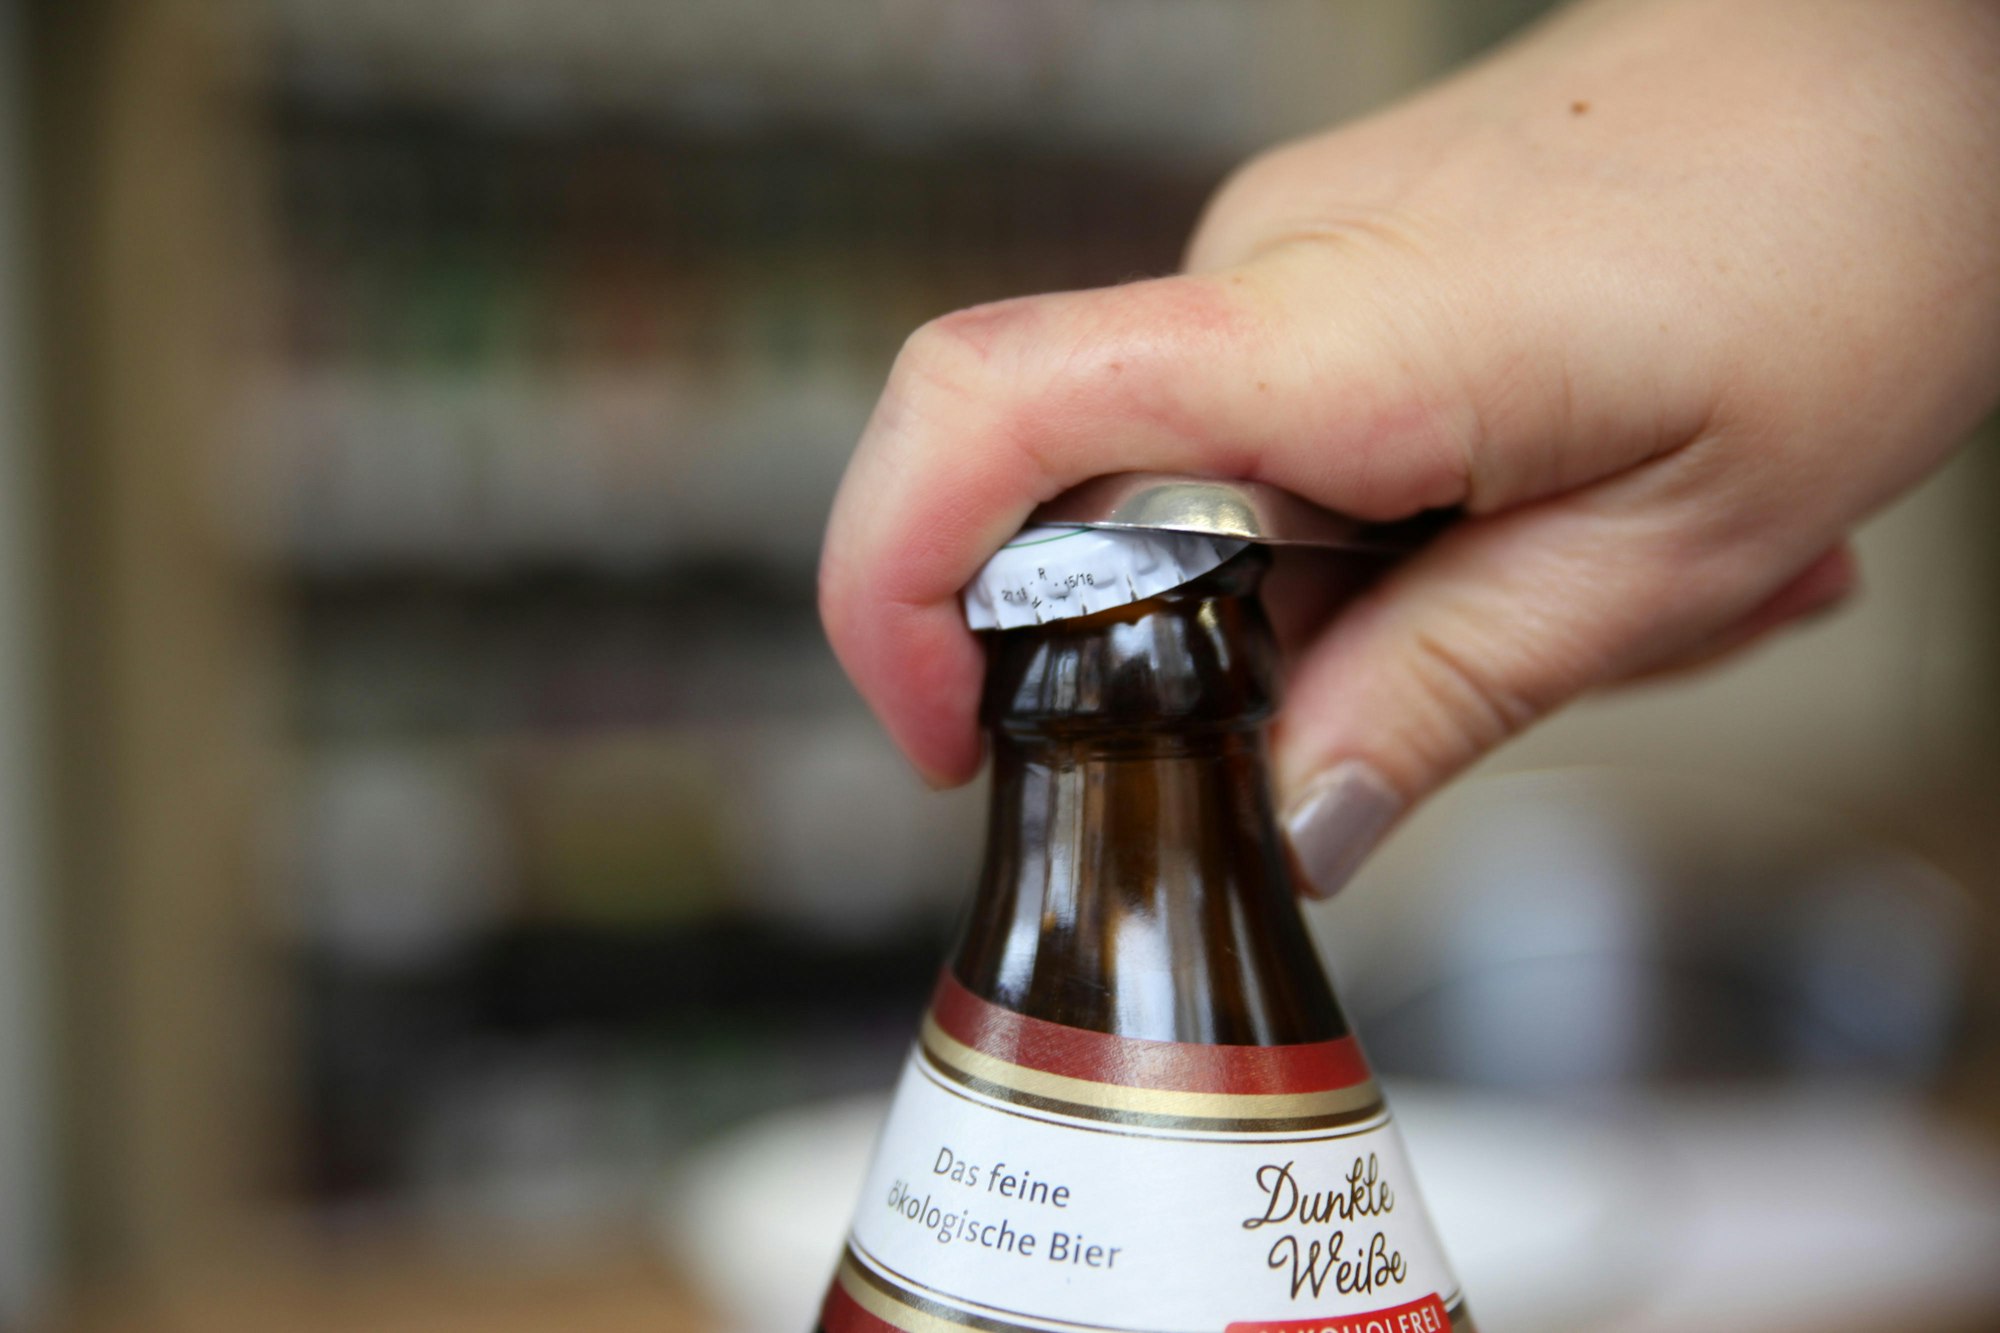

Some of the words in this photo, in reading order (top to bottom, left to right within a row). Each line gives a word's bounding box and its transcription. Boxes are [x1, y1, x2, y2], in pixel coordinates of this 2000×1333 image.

[932, 1147, 981, 1188] Das
[987, 1162, 1071, 1208] feine
[1242, 1152, 1395, 1230] Dunkle
[887, 1179, 1037, 1256] ökologische
[1049, 1231, 1123, 1270] Bier
[1267, 1230, 1407, 1300] Weiße
[1258, 1305, 1442, 1333] OLFREI
